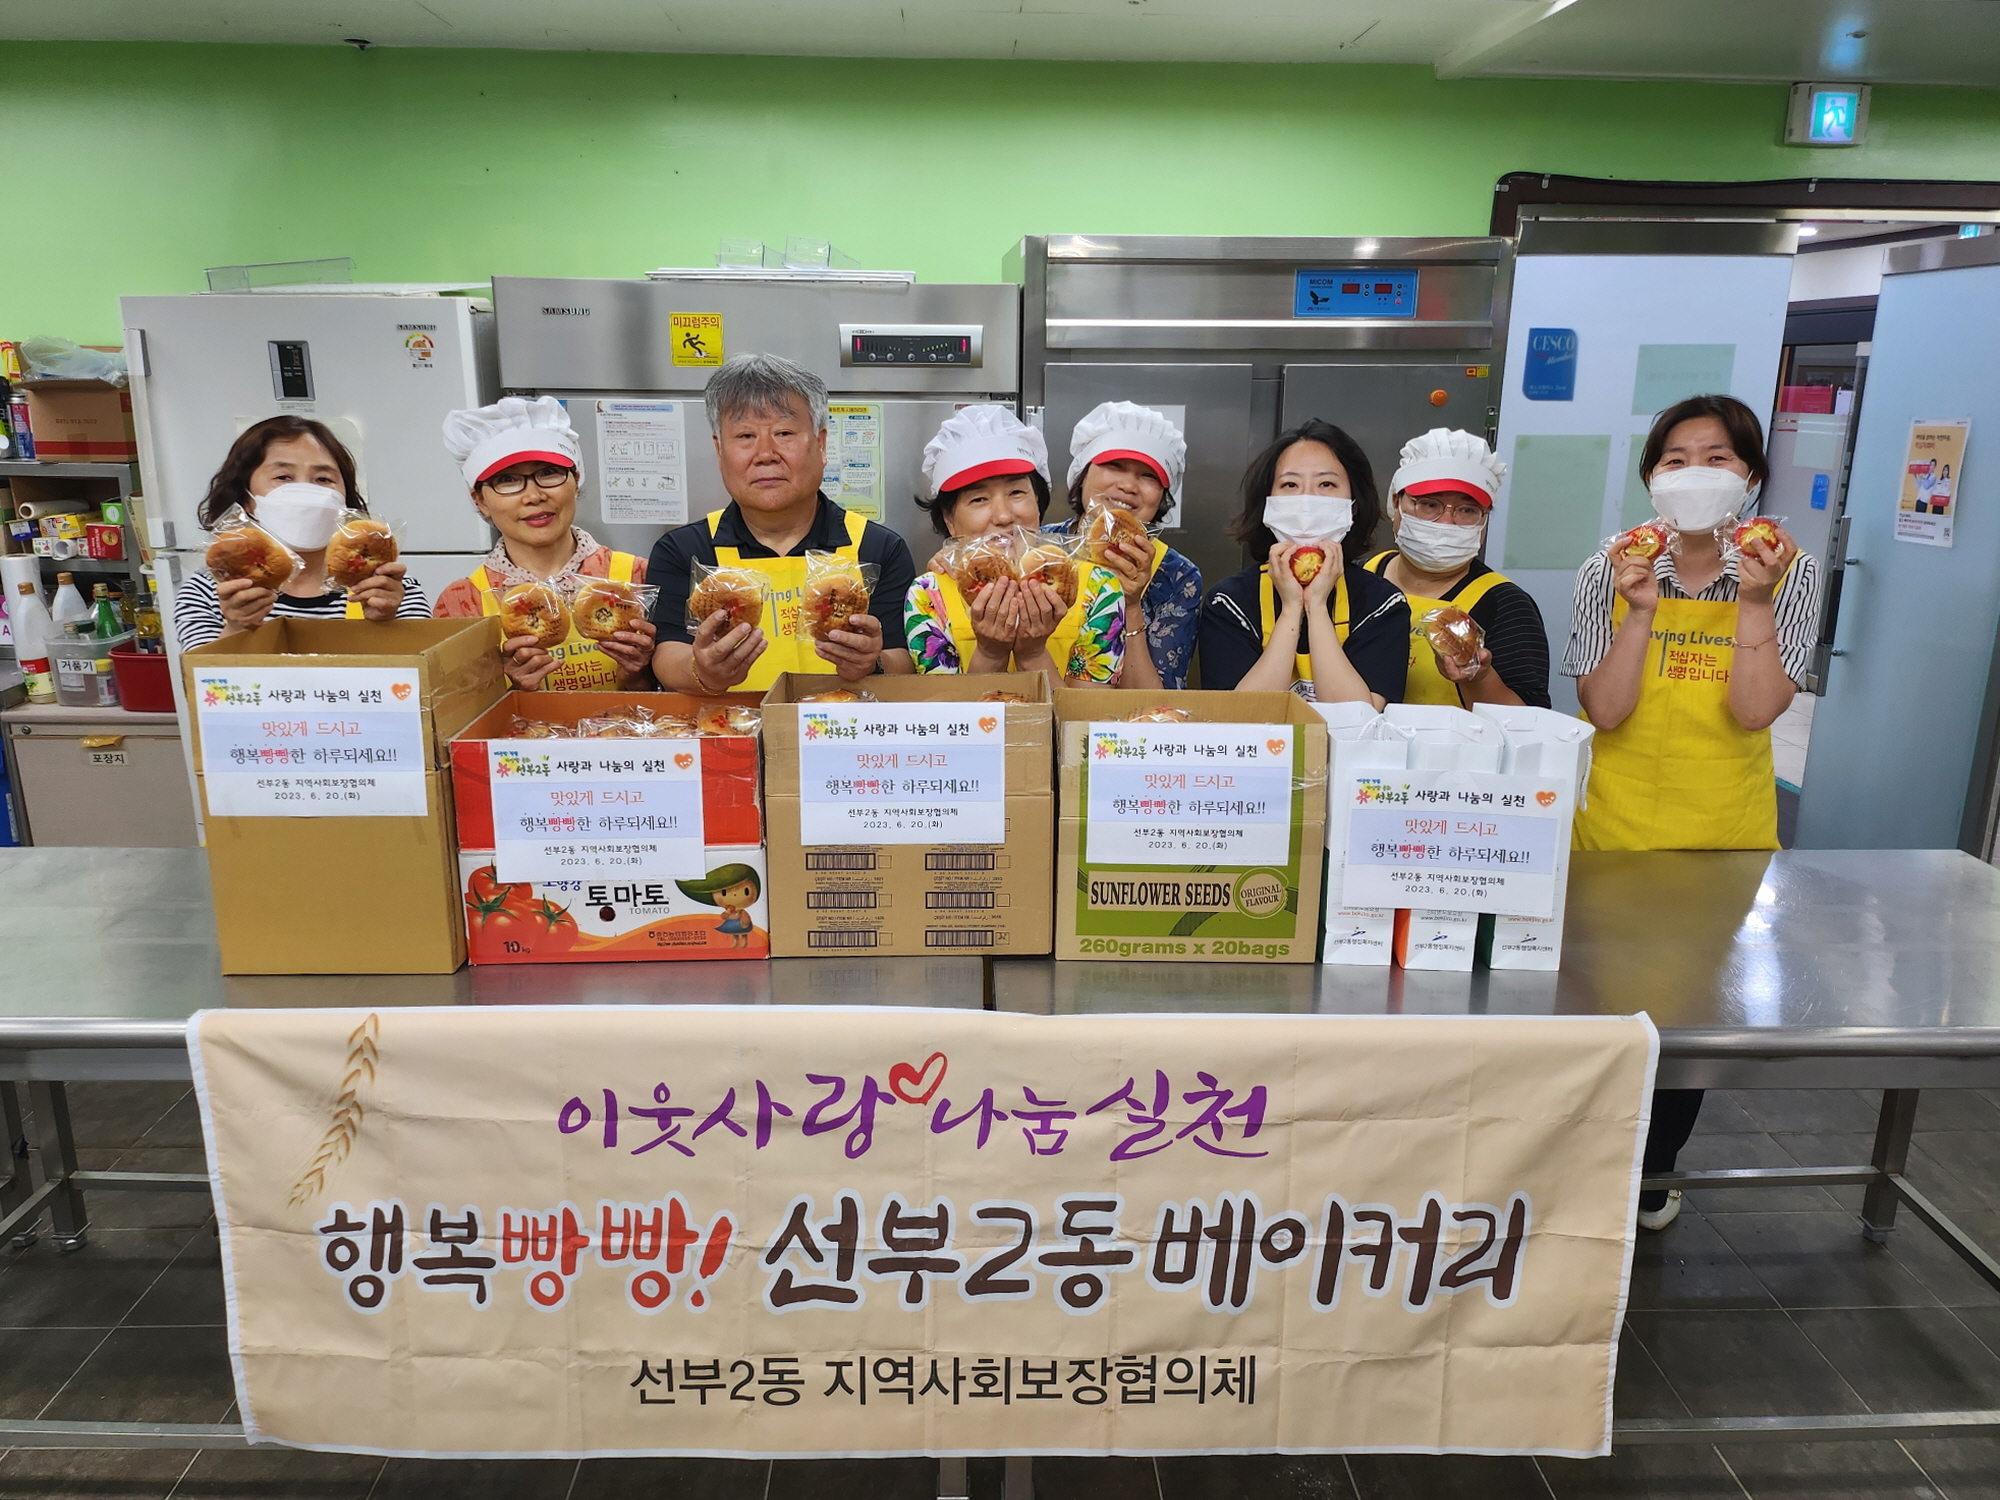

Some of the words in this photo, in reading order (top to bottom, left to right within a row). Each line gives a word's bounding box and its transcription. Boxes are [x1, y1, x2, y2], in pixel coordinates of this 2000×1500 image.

[541, 307, 590, 315] SAMSUNG
[673, 316, 720, 329] 미끄럼주의
[1533, 335, 1575, 351] CESCO
[1669, 650, 1717, 667] 적십자는
[61, 660, 94, 672] 거품기
[1667, 665, 1729, 683] 생명입니다
[553, 671, 617, 692] 생명입니다
[226, 693, 262, 706] 선부2동
[268, 689, 306, 703] 사랑과
[314, 690, 350, 703] 나눔의
[358, 690, 383, 703] 실천
[262, 721, 308, 738] 맛있게
[316, 721, 362, 737] 드시고
[824, 726, 858, 740] 선부2동
[864, 723, 898, 736] 사랑과
[906, 723, 939, 736] 나눔의
[947, 723, 969, 736] 실천
[230, 748, 306, 764] 행복빵빵한
[314, 748, 397, 764] 하루되세요!!
[1114, 745, 1147, 759] 선부2동
[1152, 744, 1186, 757] 사랑과
[1194, 744, 1227, 758] 나눔의
[1235, 744, 1258, 758] 실천
[93, 753, 125, 764] 포장지
[856, 753, 898, 769] 맛있게
[905, 753, 948, 768] 드시고
[516, 763, 551, 777] 선부2동
[556, 760, 592, 774] 사랑과
[600, 760, 634, 773] 나눔의
[642, 760, 666, 773] 실천
[256, 778, 290, 789] 선부2동
[295, 778, 376, 788] 지역사회보장협의체
[826, 779, 895, 795] 행복빵빵한
[902, 779, 979, 794] 하루되세요!!
[1144, 774, 1186, 789] 맛있게
[1193, 774, 1235, 789] 드시고
[275, 792, 306, 800] 2023.
[311, 792, 321, 800] 6.
[326, 791, 361, 801] 20.(화)
[551, 790, 594, 806] 맛있게
[601, 790, 644, 805] 드시고
[1376, 791, 1409, 805] 선부2동
[1415, 790, 1450, 802] 사랑과
[1458, 792, 1493, 804] 나눔의
[1501, 794, 1525, 808] 실천
[848, 808, 879, 818] 선부2동
[884, 807, 958, 817] 지역사회보장협의체
[1113, 799, 1182, 815] 행복빵빵한
[1189, 800, 1266, 815] 하루되세요!!
[520, 816, 591, 833] 행복빵빵한
[599, 815, 678, 831] 하루되세요!!
[863, 821, 892, 829] 2023.
[897, 821, 906, 829] 6.
[911, 820, 943, 829] 20.(화)
[1405, 819, 1447, 835] 맛있게
[1454, 820, 1498, 837] 드시고
[1134, 828, 1165, 838] 선부2동
[1169, 829, 1243, 838] 지역사회보장협의체
[544, 845, 576, 856] 선부2동
[581, 844, 658, 854] 지역사회보장협의체
[1148, 841, 1176, 850] 2023.
[1182, 842, 1191, 850] 6.
[1196, 842, 1228, 851] 20.(화)
[1371, 843, 1442, 859] 행복빵빵한
[1449, 846, 1530, 864] 하루되세요!!
[561, 857, 590, 866] 2023.
[595, 857, 605, 866] 6.
[609, 856, 643, 866] 20.(화)
[1390, 872, 1422, 882] 선부2동
[1427, 873, 1504, 886] 지역사회보장협의체
[585, 883, 669, 907] 토마토
[1091, 881, 1181, 906] SUNFLOWER
[1185, 882, 1231, 907] SEEDS
[1241, 884, 1282, 898] ORIGINAL
[1405, 885, 1433, 894] 2023.
[1439, 886, 1448, 895] 6.
[1454, 887, 1488, 899] 20.(화)
[1245, 894, 1279, 908] FLAVOUR
[629, 907, 670, 915] TOMATO
[1079, 938, 1187, 957] 260grams
[1193, 944, 1206, 955] x
[1212, 940, 1290, 958] 20bags
[558, 1072, 896, 1160] 이웃사랑
[930, 1069, 1270, 1162] 나눔실천
[319, 1197, 733, 1308] 행복빵빵!
[765, 1196, 1134, 1308] 선부2동
[1152, 1198, 1526, 1307] 베이커리
[630, 1356, 805, 1405] 선부2동
[823, 1355, 1256, 1405] 지역사회보장협의체
